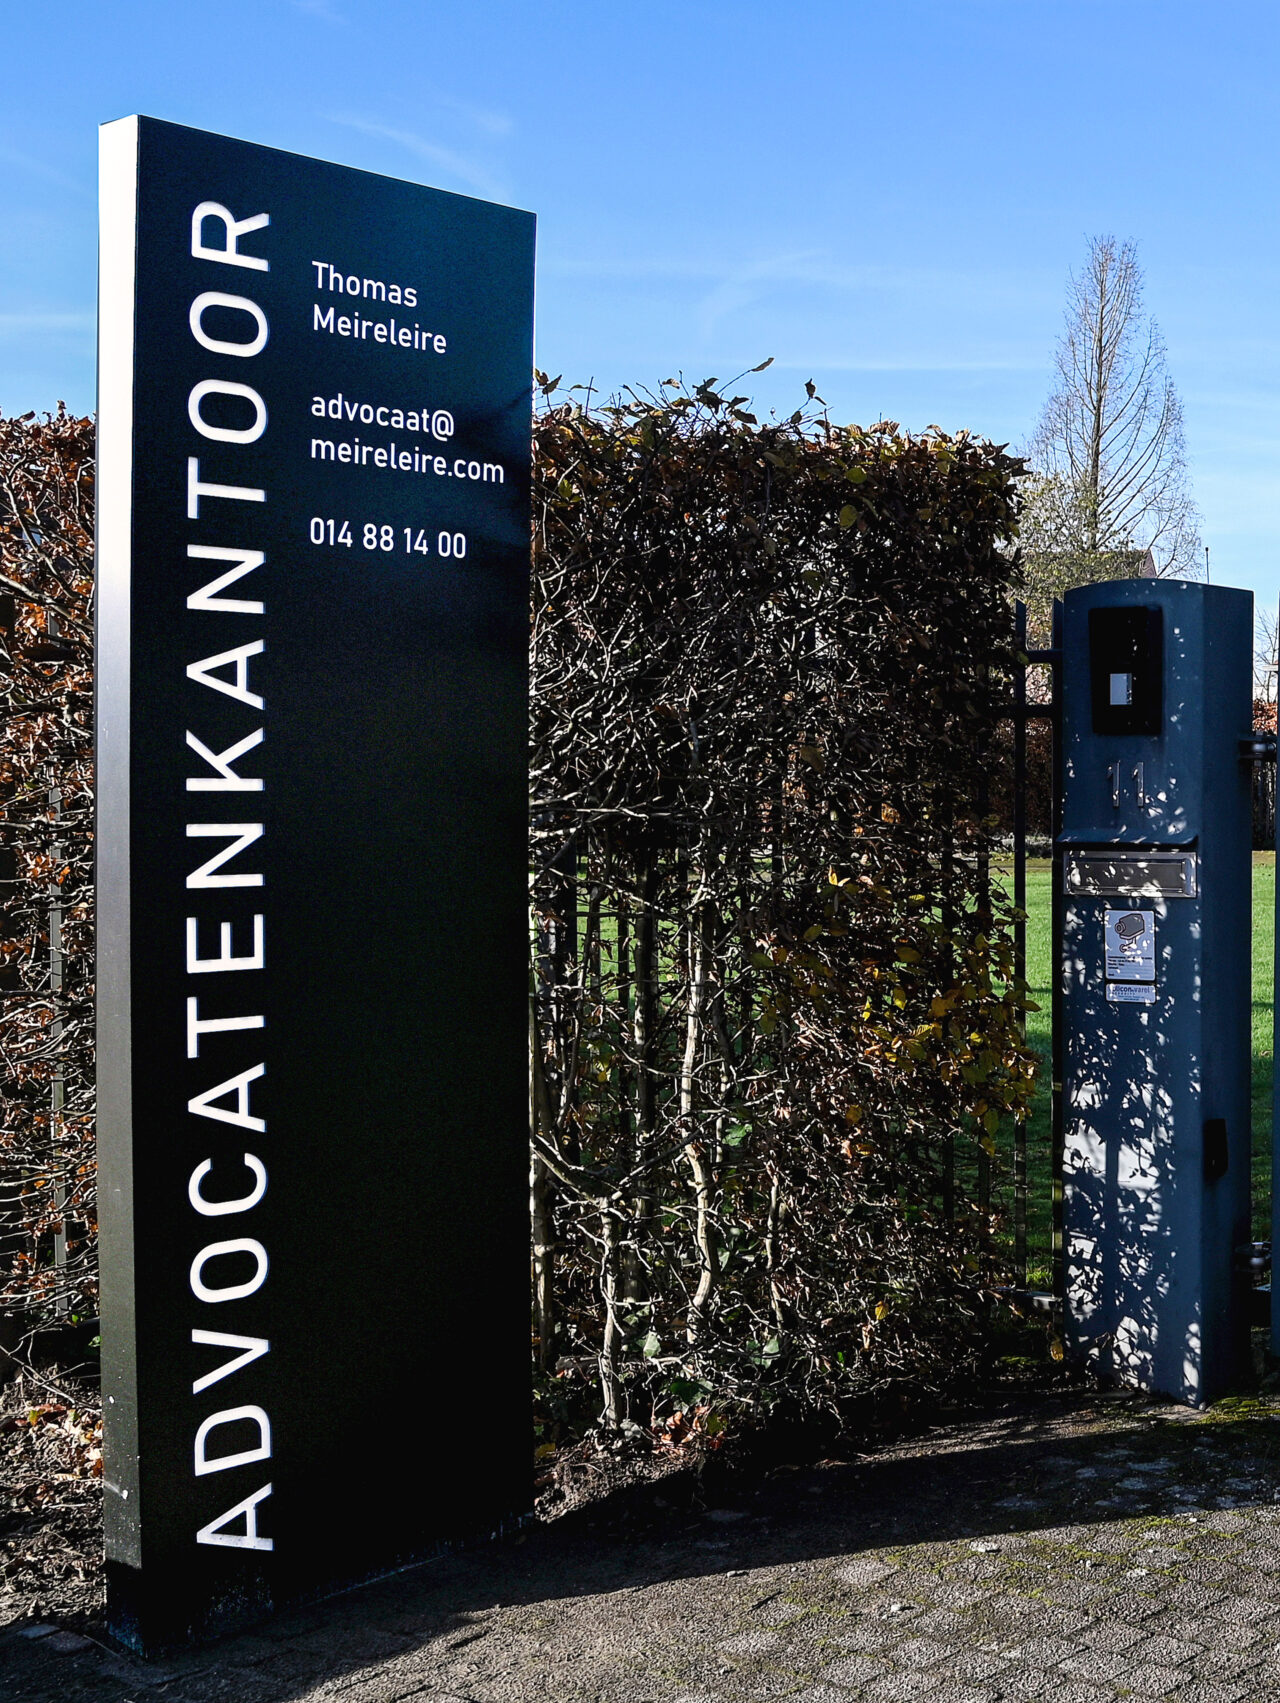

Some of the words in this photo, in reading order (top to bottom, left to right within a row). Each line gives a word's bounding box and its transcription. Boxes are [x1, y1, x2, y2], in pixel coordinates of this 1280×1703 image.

[310, 260, 418, 308] Thomas
[312, 303, 448, 355] Meireleire
[311, 392, 456, 442] advocaat@
[310, 438, 505, 485] meireleire.com
[310, 517, 353, 548] 014
[362, 523, 395, 552] 88
[403, 527, 429, 555] 14
[438, 530, 467, 559] 00
[1106, 761, 1144, 807] 11
[185, 200, 273, 1551] ADVOCATENKANTOOR
